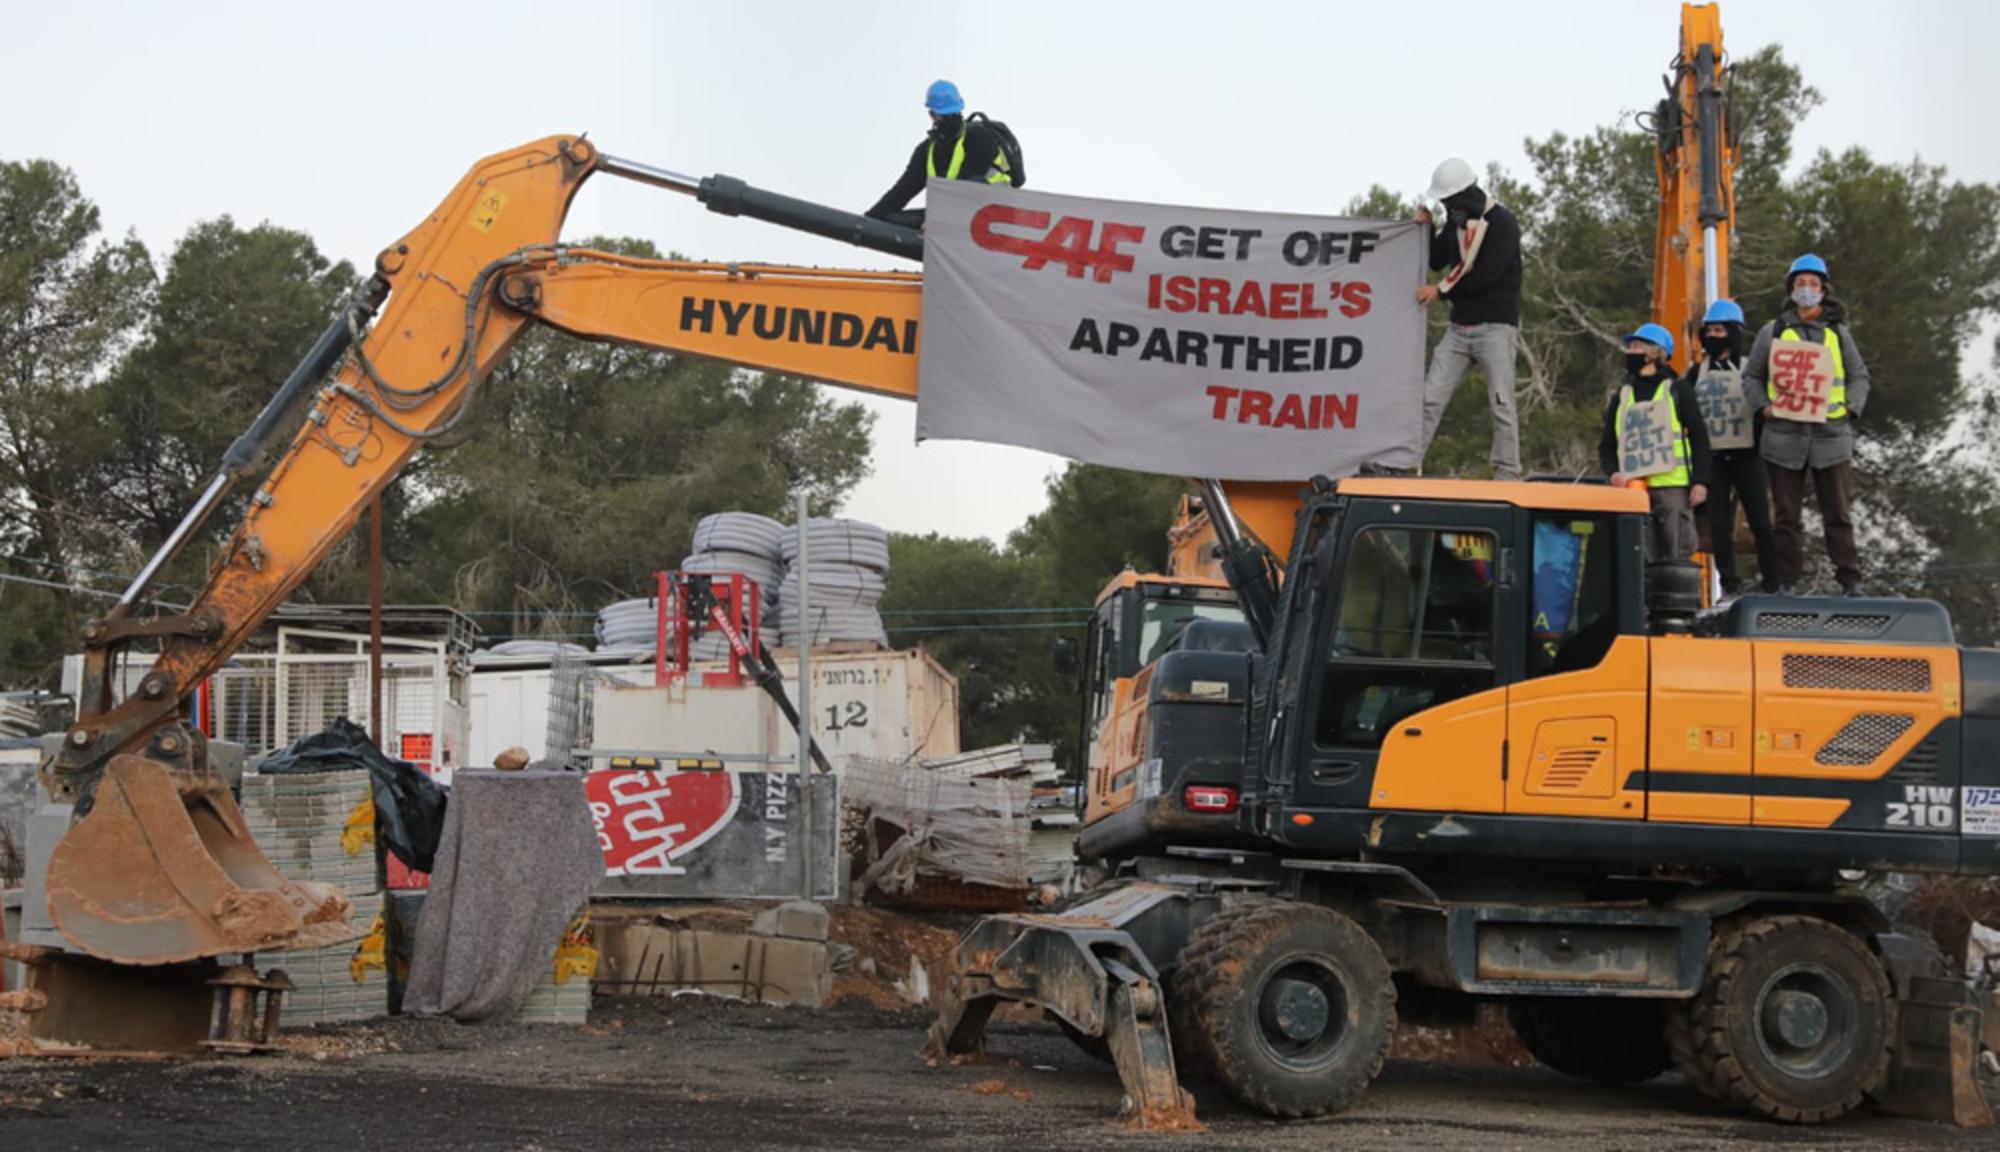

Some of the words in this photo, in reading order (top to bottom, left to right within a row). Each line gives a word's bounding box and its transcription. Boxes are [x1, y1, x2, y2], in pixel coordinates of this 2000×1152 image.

[970, 204, 1145, 283] CAF
[1159, 225, 1262, 261] GET
[1282, 231, 1380, 266] OFF
[1148, 274, 1372, 319] ISRAEL'S
[680, 296, 918, 354] HYUNDAI
[1069, 318, 1363, 373] APARTHEID
[1773, 372, 1825, 393] GET
[1206, 386, 1359, 430] TRAIN
[1776, 390, 1825, 415] OUT
[825, 700, 868, 731] 12
[1905, 785, 1953, 804] HW
[1885, 803, 1953, 827] 210
